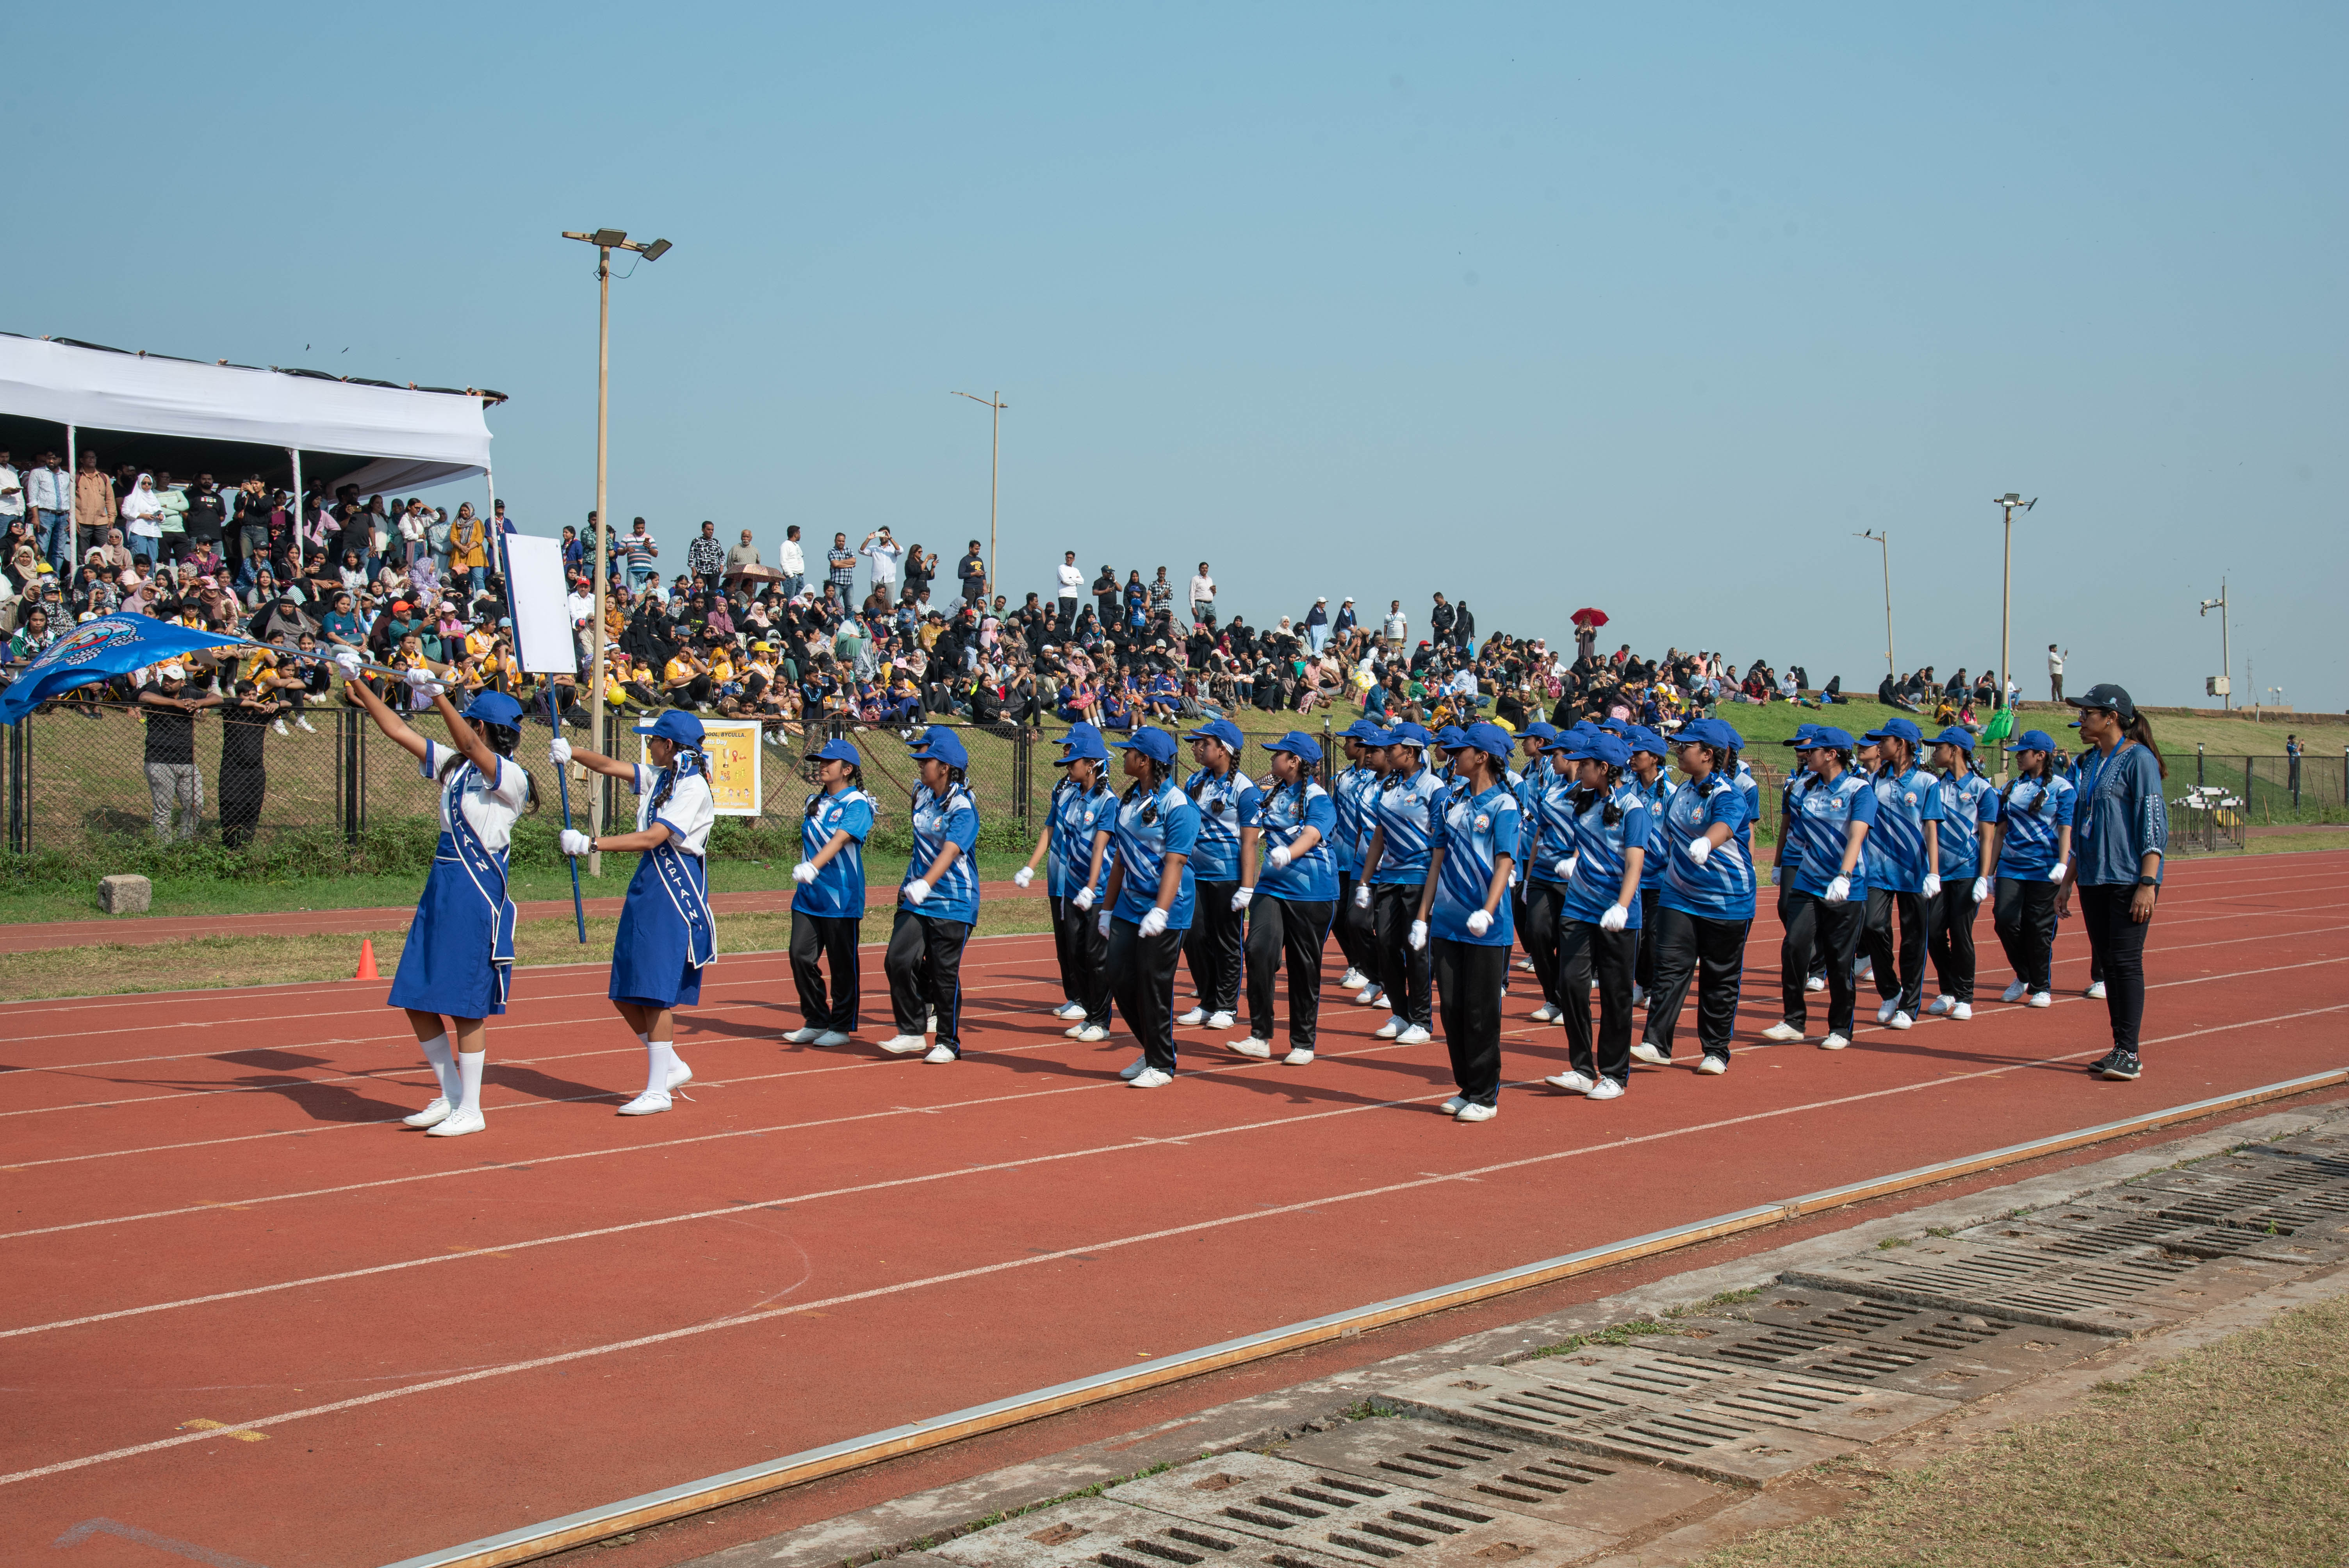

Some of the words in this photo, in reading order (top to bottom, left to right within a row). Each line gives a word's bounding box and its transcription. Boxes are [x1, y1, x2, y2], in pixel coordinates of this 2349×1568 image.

[716, 738, 727, 746] Day
[452, 784, 489, 872] CAPTAIN
[659, 847, 698, 920] CAPTAIN
